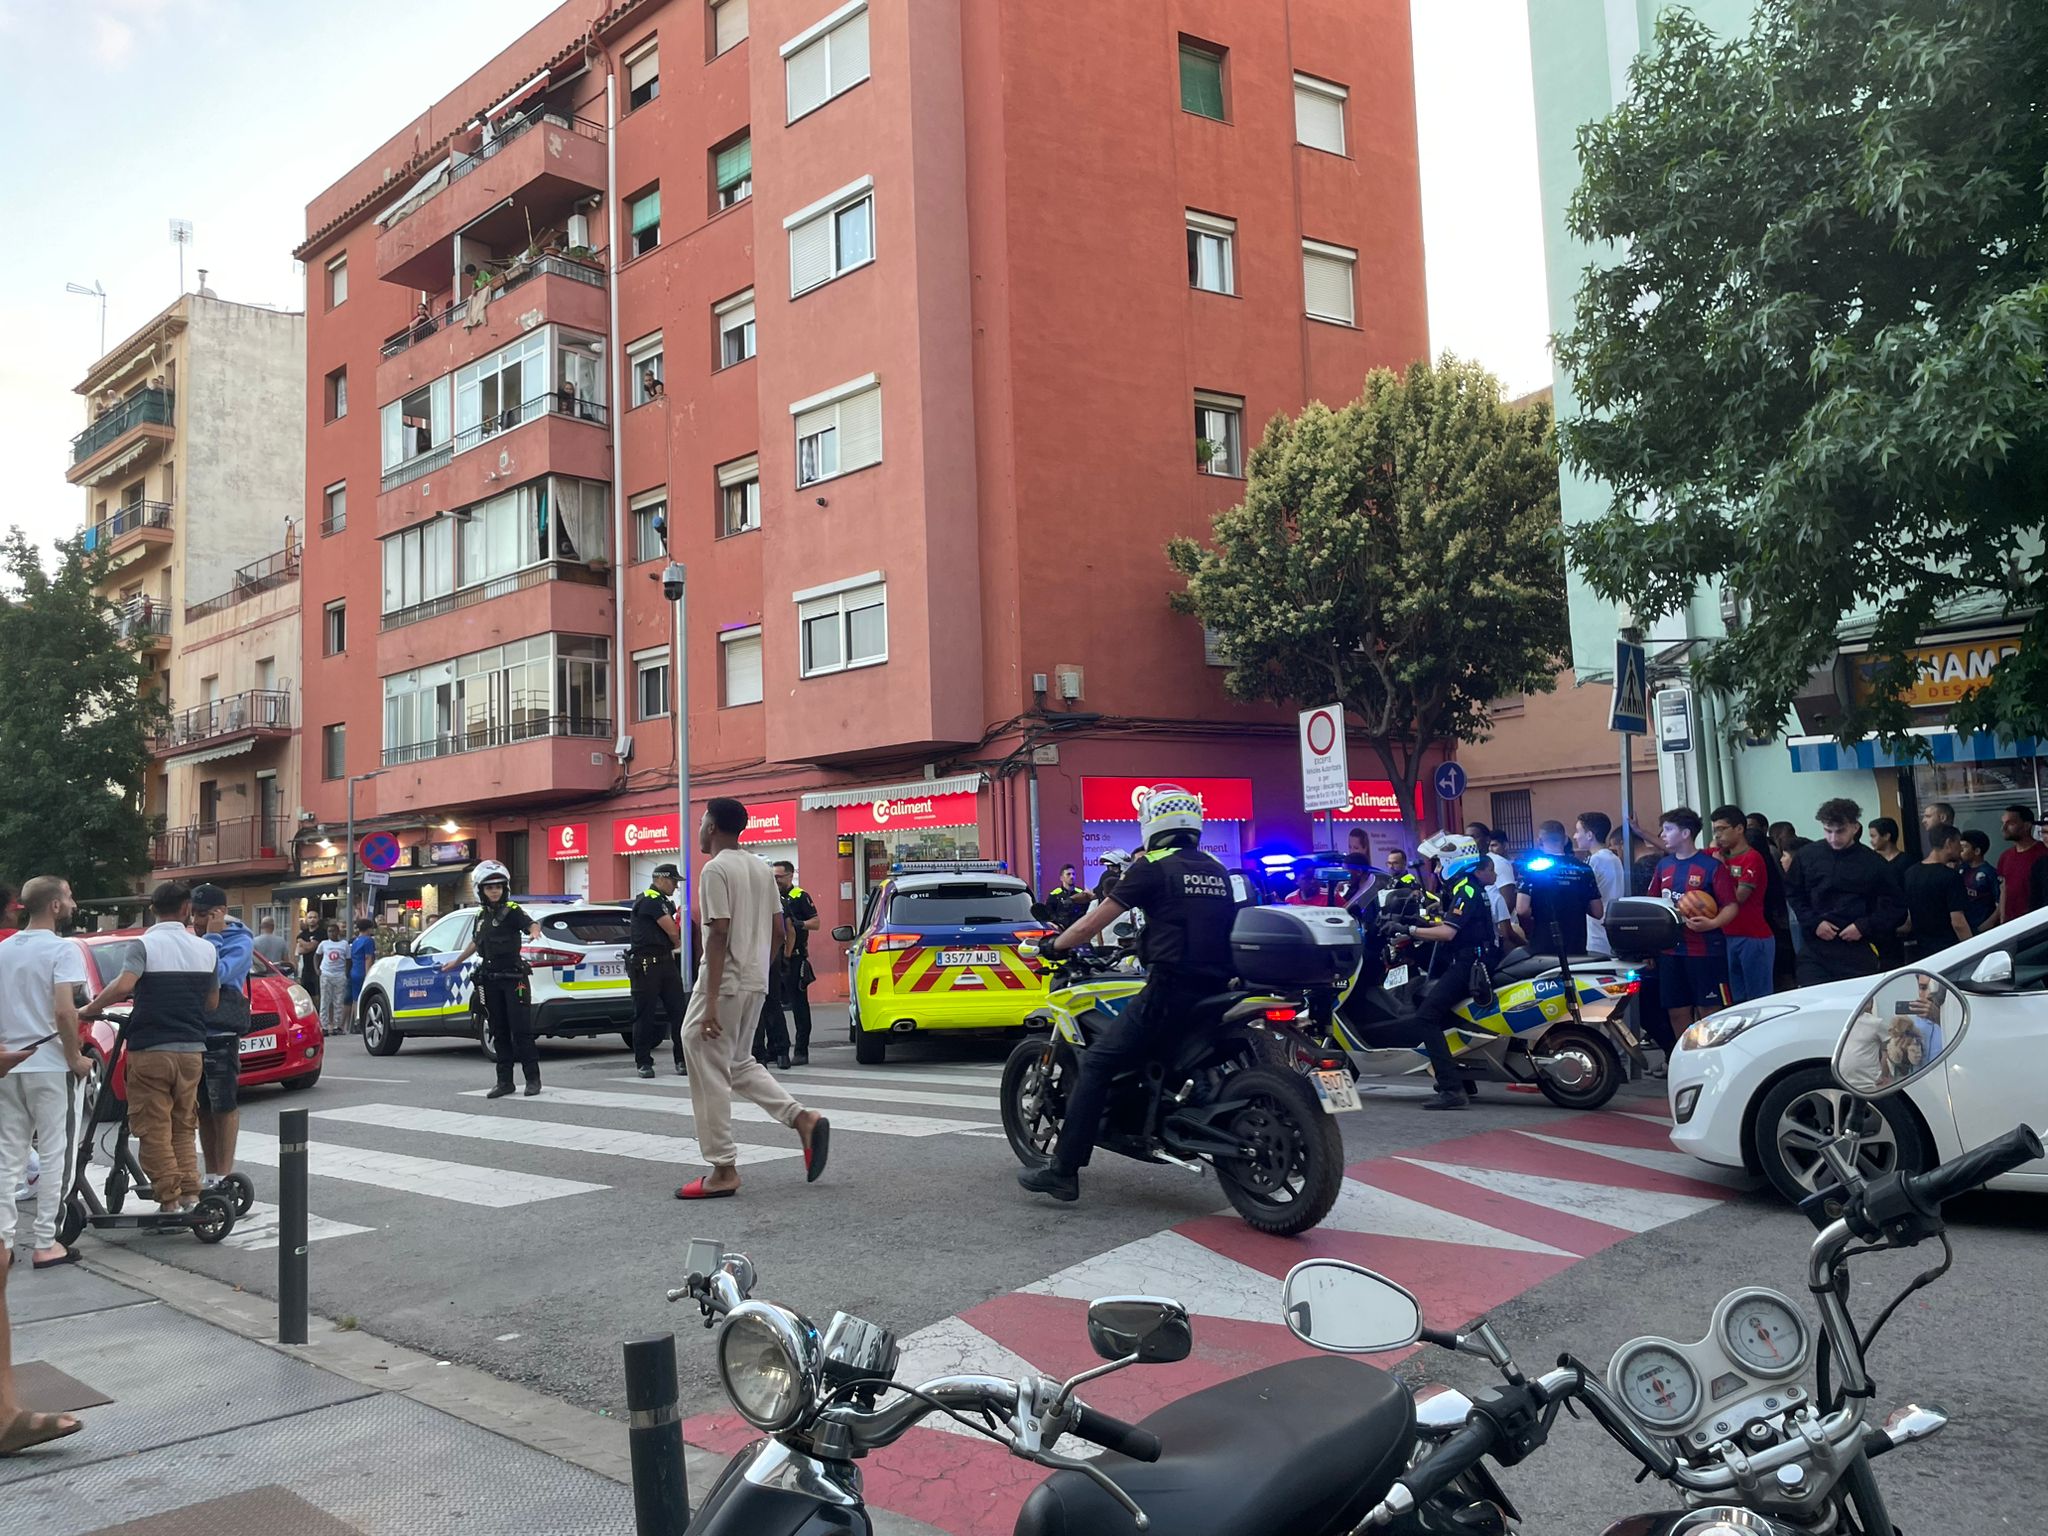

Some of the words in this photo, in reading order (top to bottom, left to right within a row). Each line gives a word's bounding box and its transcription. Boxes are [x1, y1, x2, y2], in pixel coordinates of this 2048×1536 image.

[1183, 874, 1226, 888] POLICIA
[945, 953, 972, 963] 3577
[976, 953, 997, 963] MJB
[1509, 981, 1558, 1003] POLICIA
[250, 1036, 273, 1050] FXV
